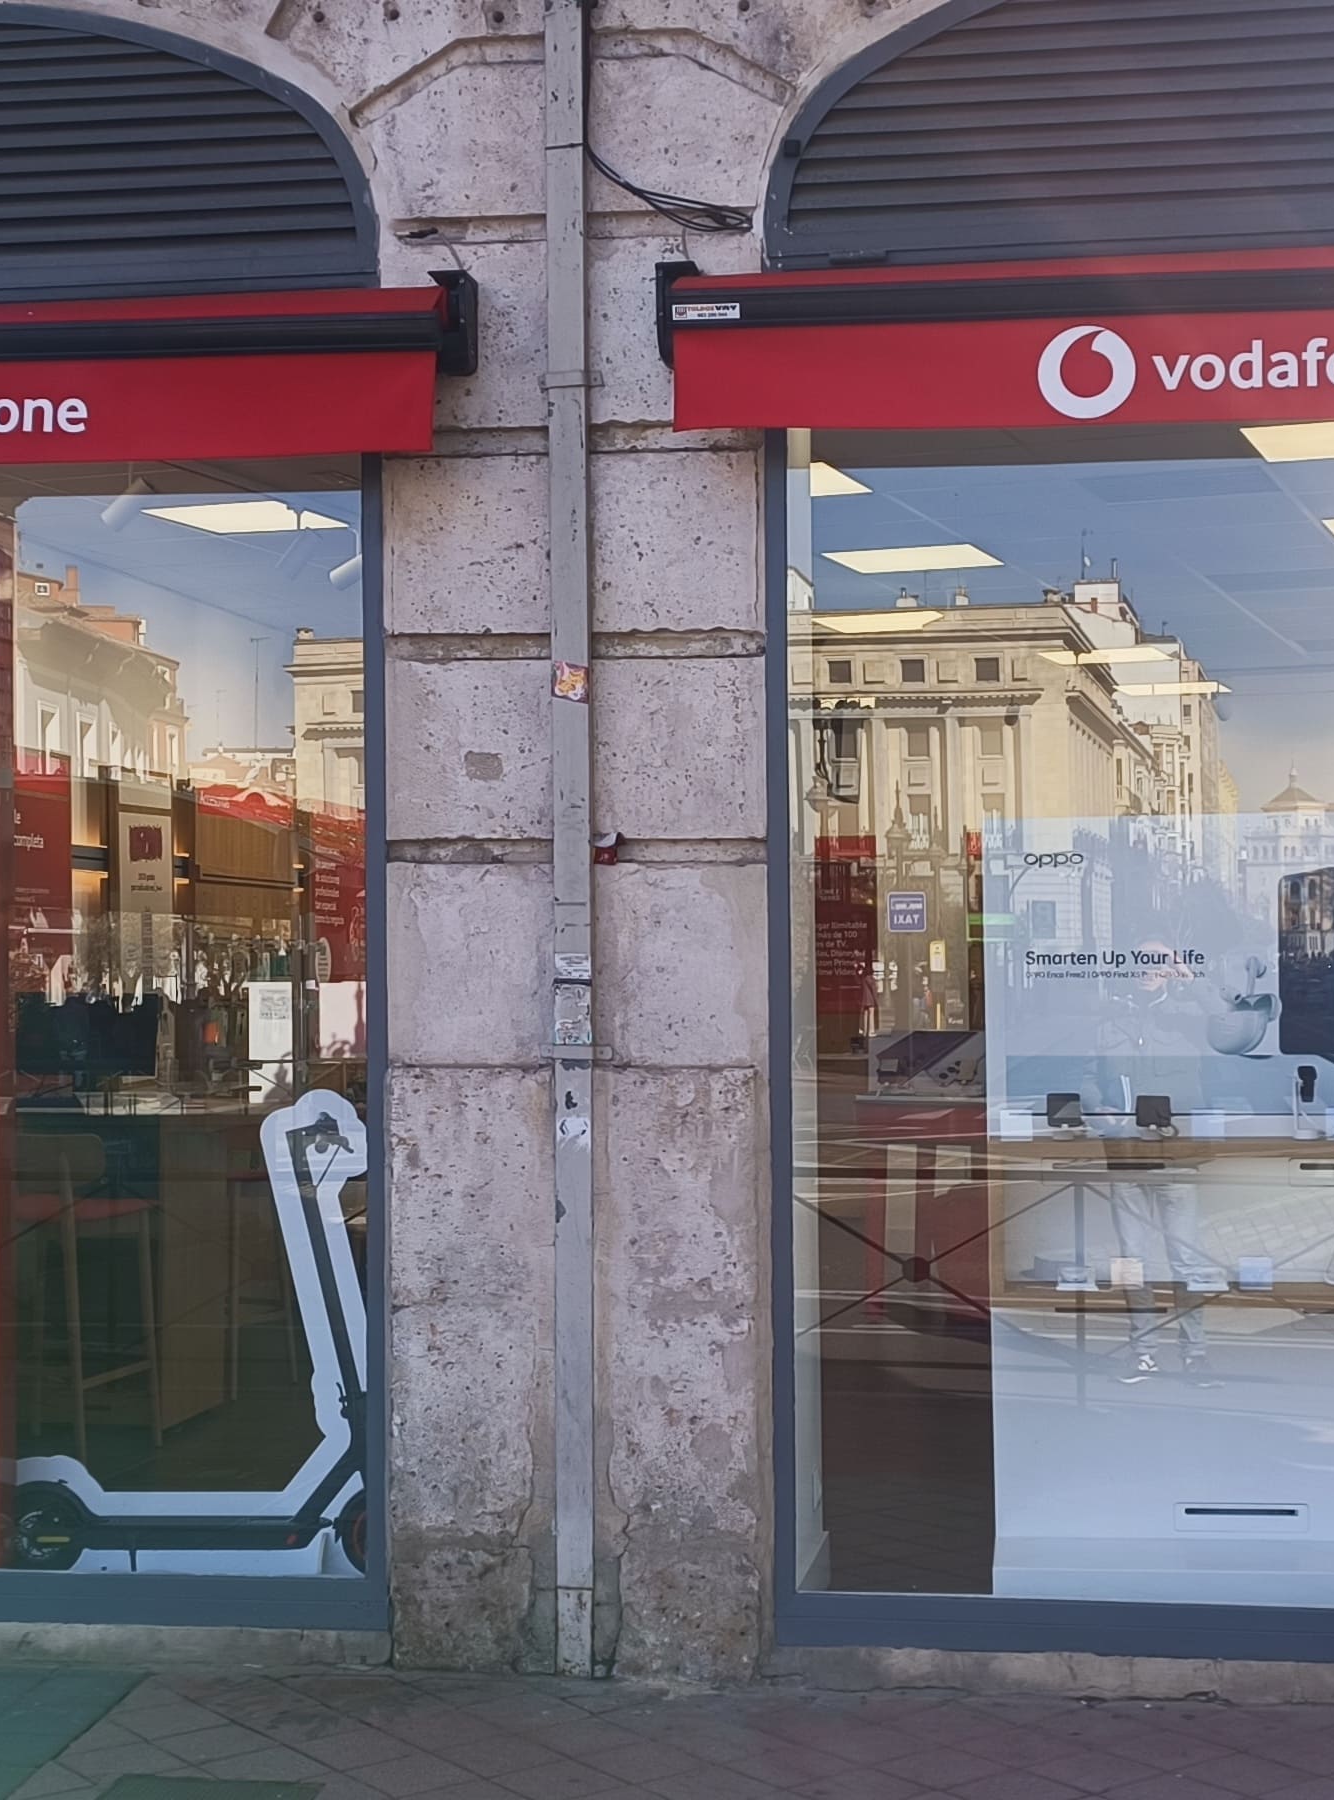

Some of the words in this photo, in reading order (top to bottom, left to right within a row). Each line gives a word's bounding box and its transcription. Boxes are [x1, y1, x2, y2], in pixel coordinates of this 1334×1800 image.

[1025, 949, 1098, 966] Smarten
[1102, 949, 1127, 969] Up
[1130, 949, 1169, 966] Your
[1173, 948, 1205, 966] Life
